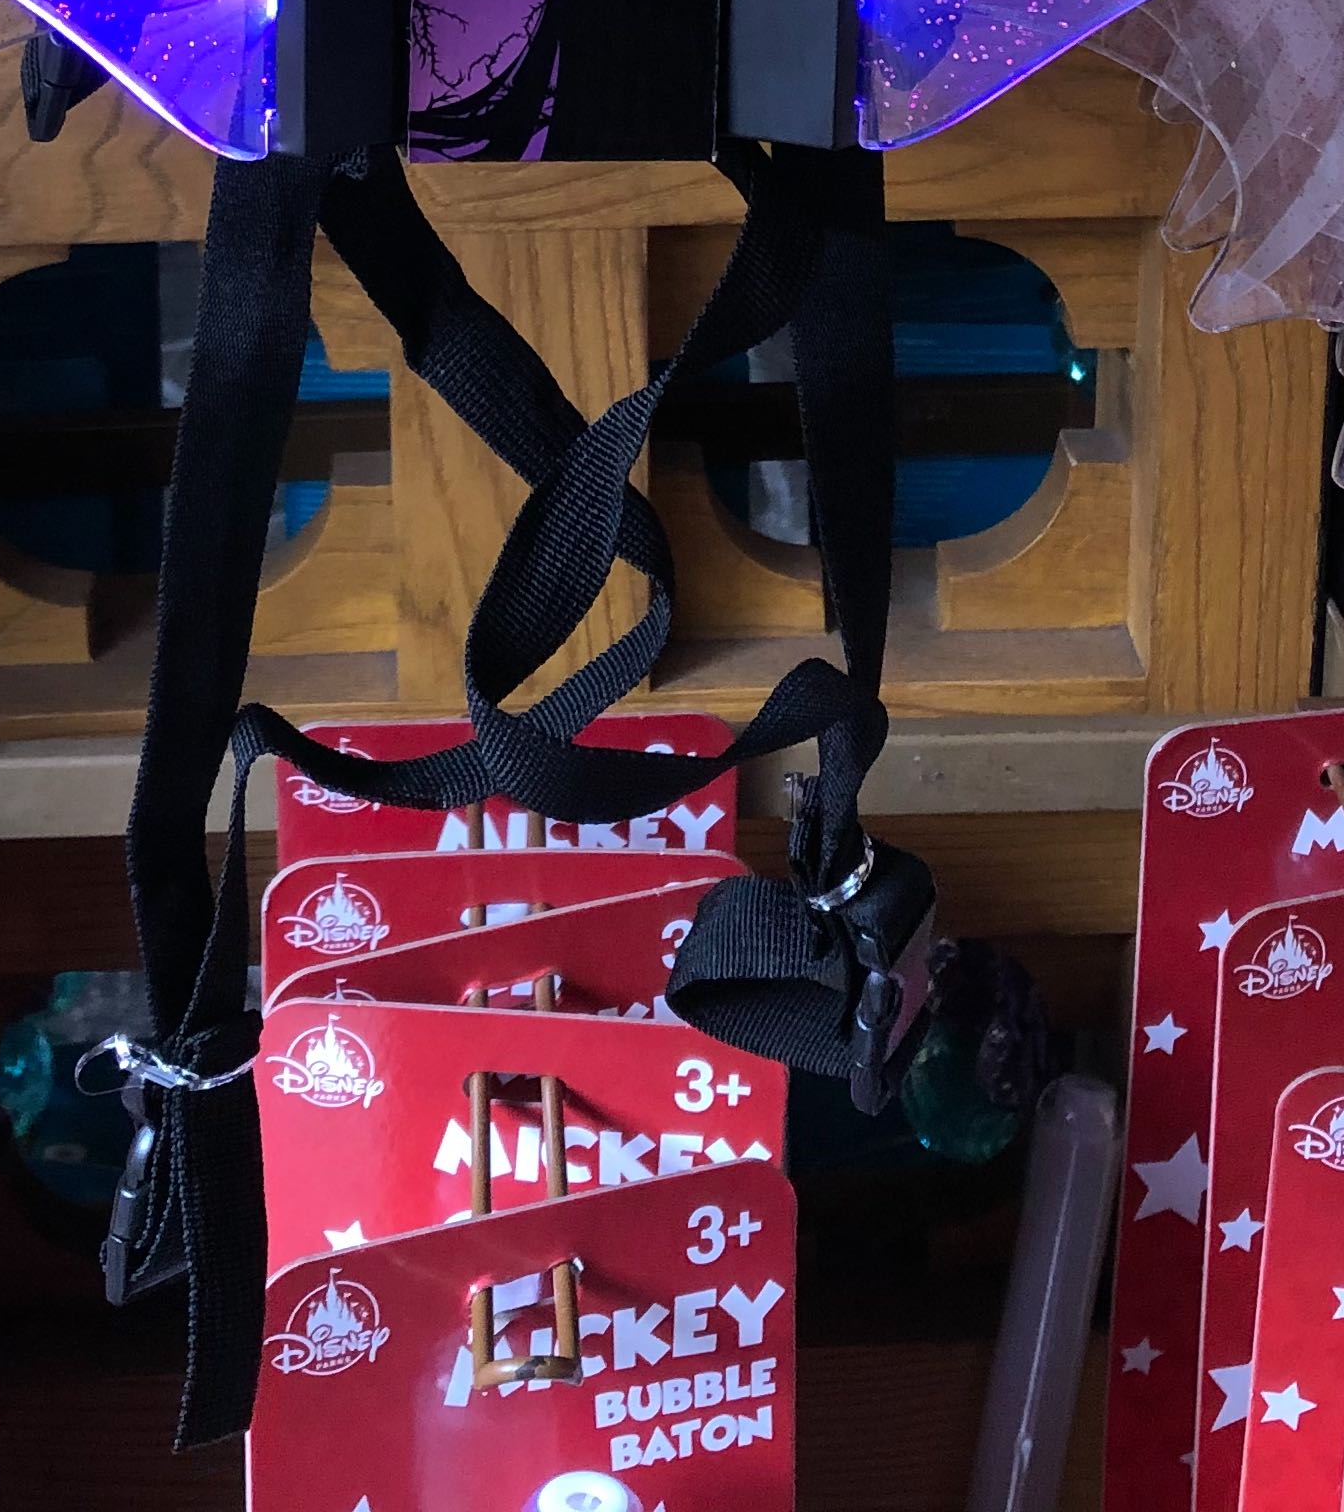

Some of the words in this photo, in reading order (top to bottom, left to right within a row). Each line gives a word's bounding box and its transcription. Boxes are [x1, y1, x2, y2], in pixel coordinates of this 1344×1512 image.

[674, 1059, 752, 1113] 3+
[686, 1205, 763, 1265] 3+
[595, 1357, 777, 1429] BUBBLE
[611, 1405, 774, 1472] BATON
